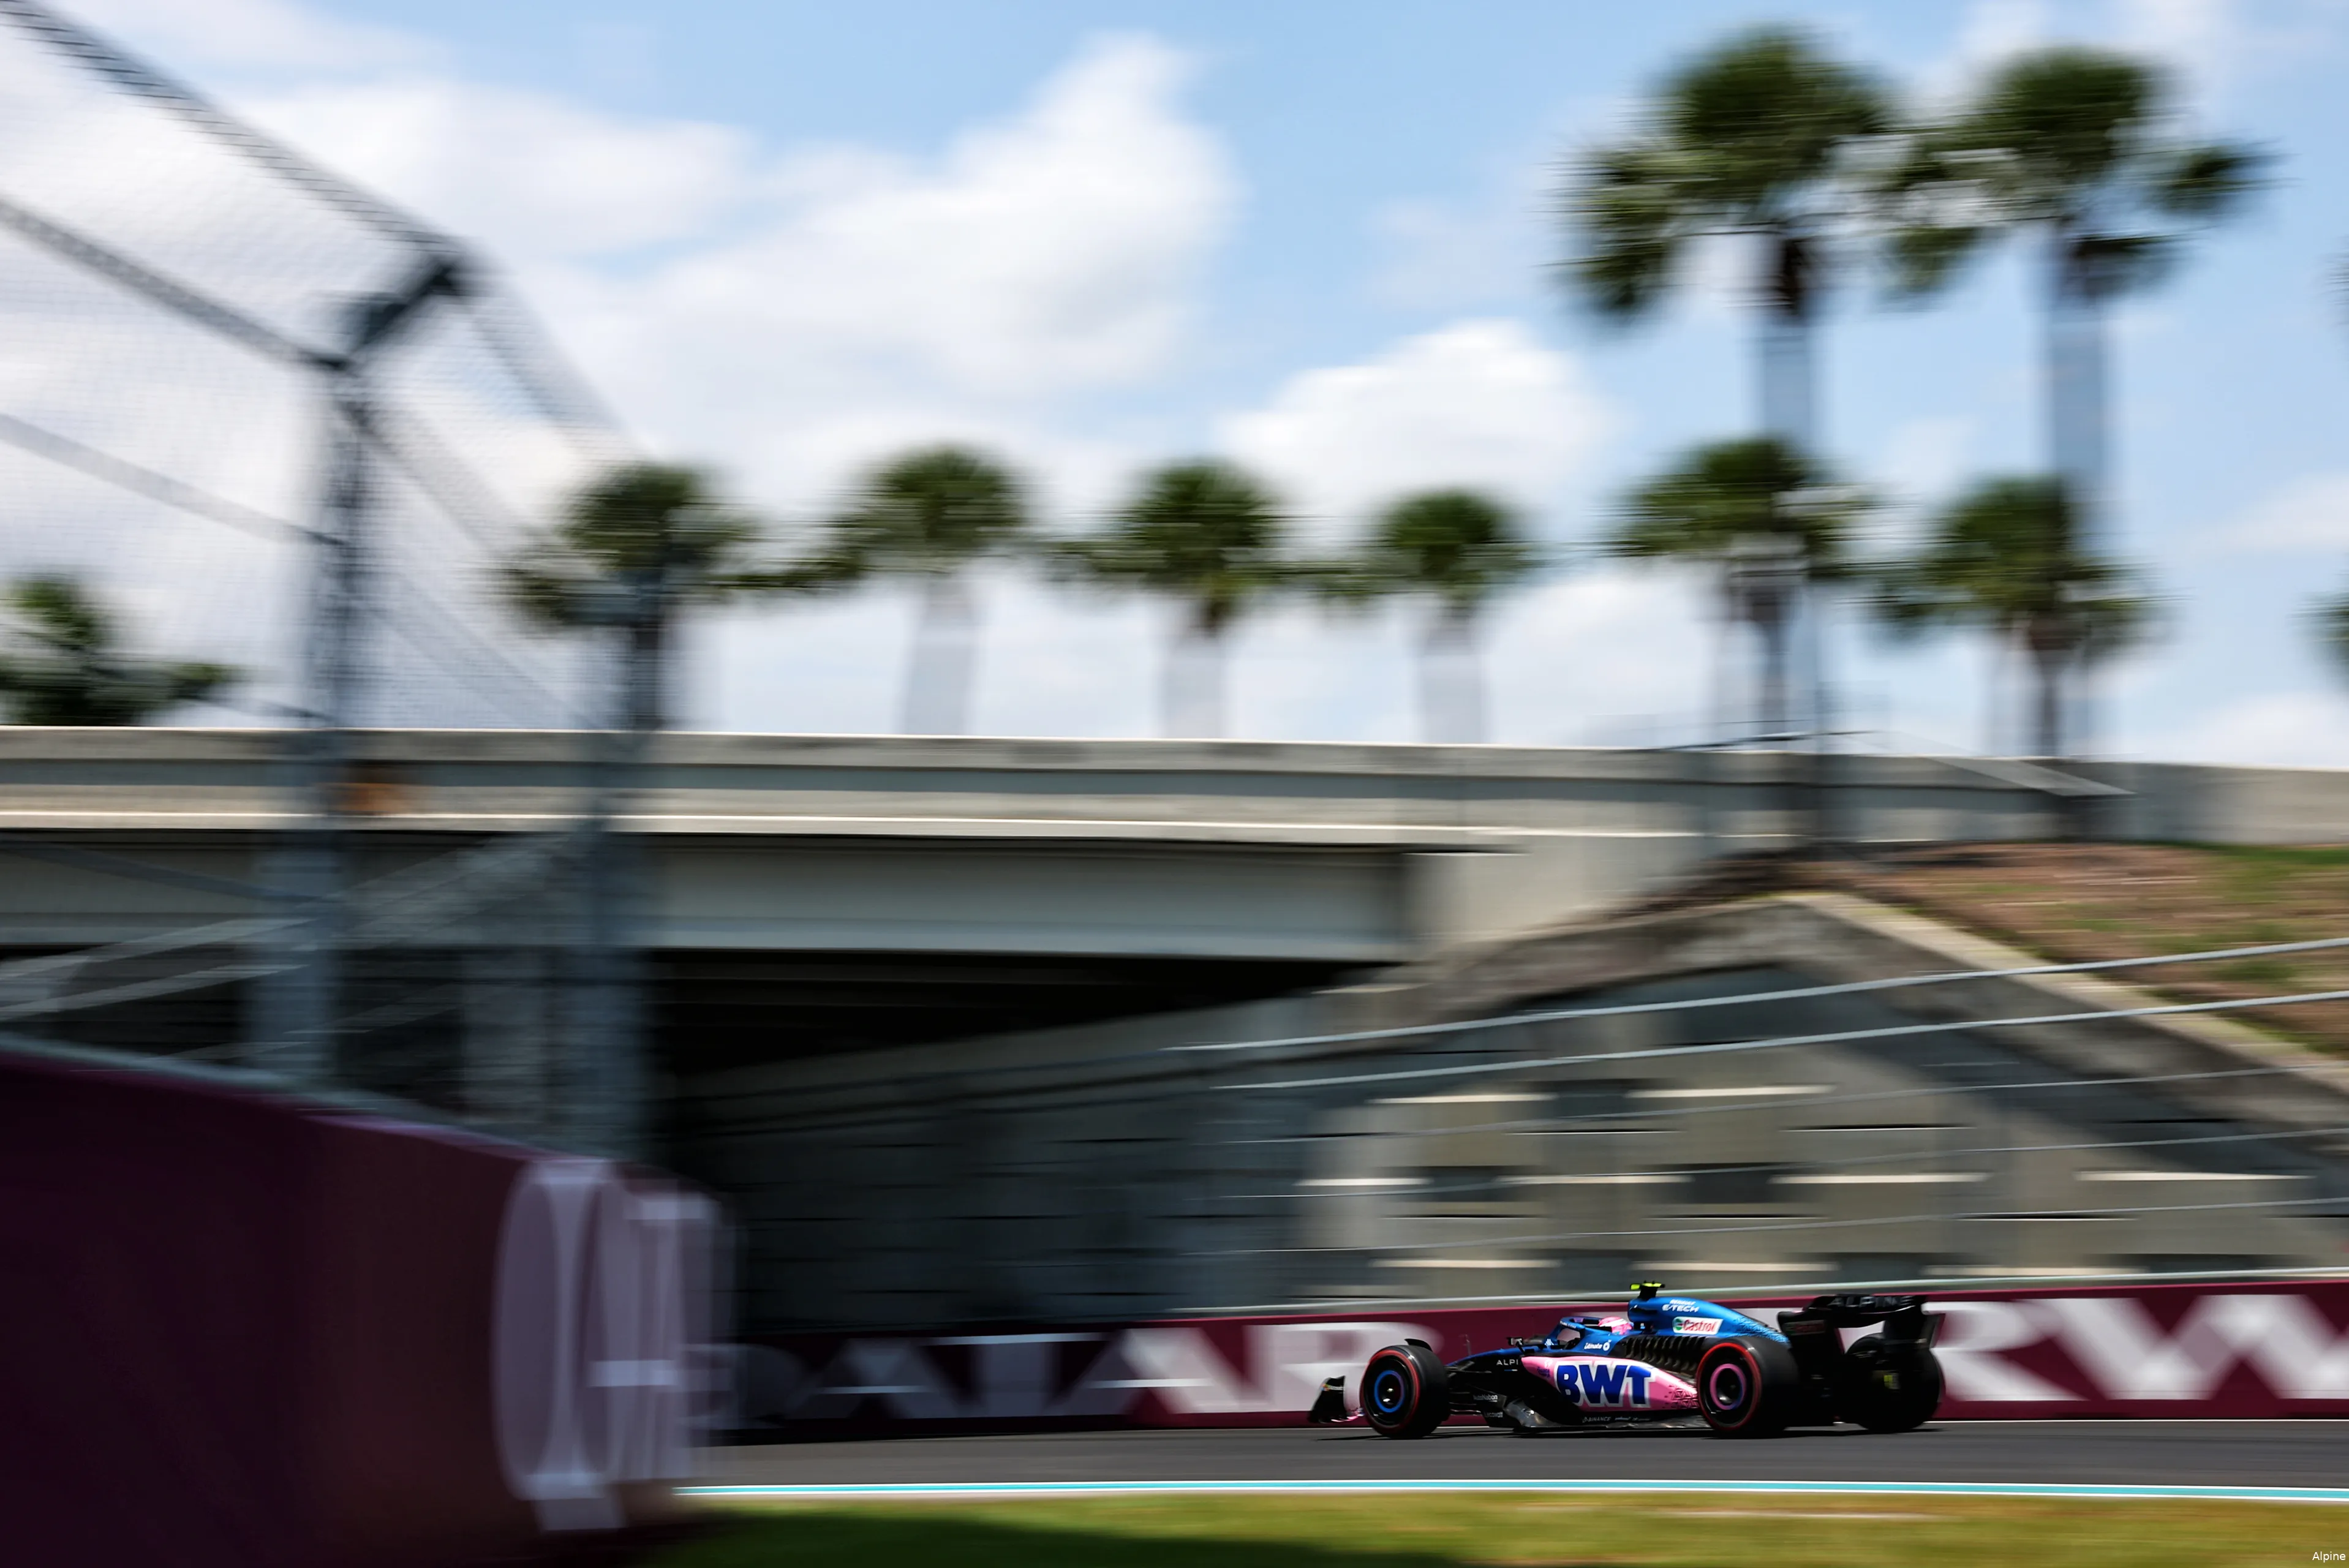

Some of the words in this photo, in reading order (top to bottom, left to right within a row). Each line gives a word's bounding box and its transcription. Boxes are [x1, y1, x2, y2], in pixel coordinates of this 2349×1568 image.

[1827, 1295, 1914, 1308] ALPINE
[1683, 1319, 1716, 1332] Castrol
[1556, 1363, 1653, 1406] BWT
